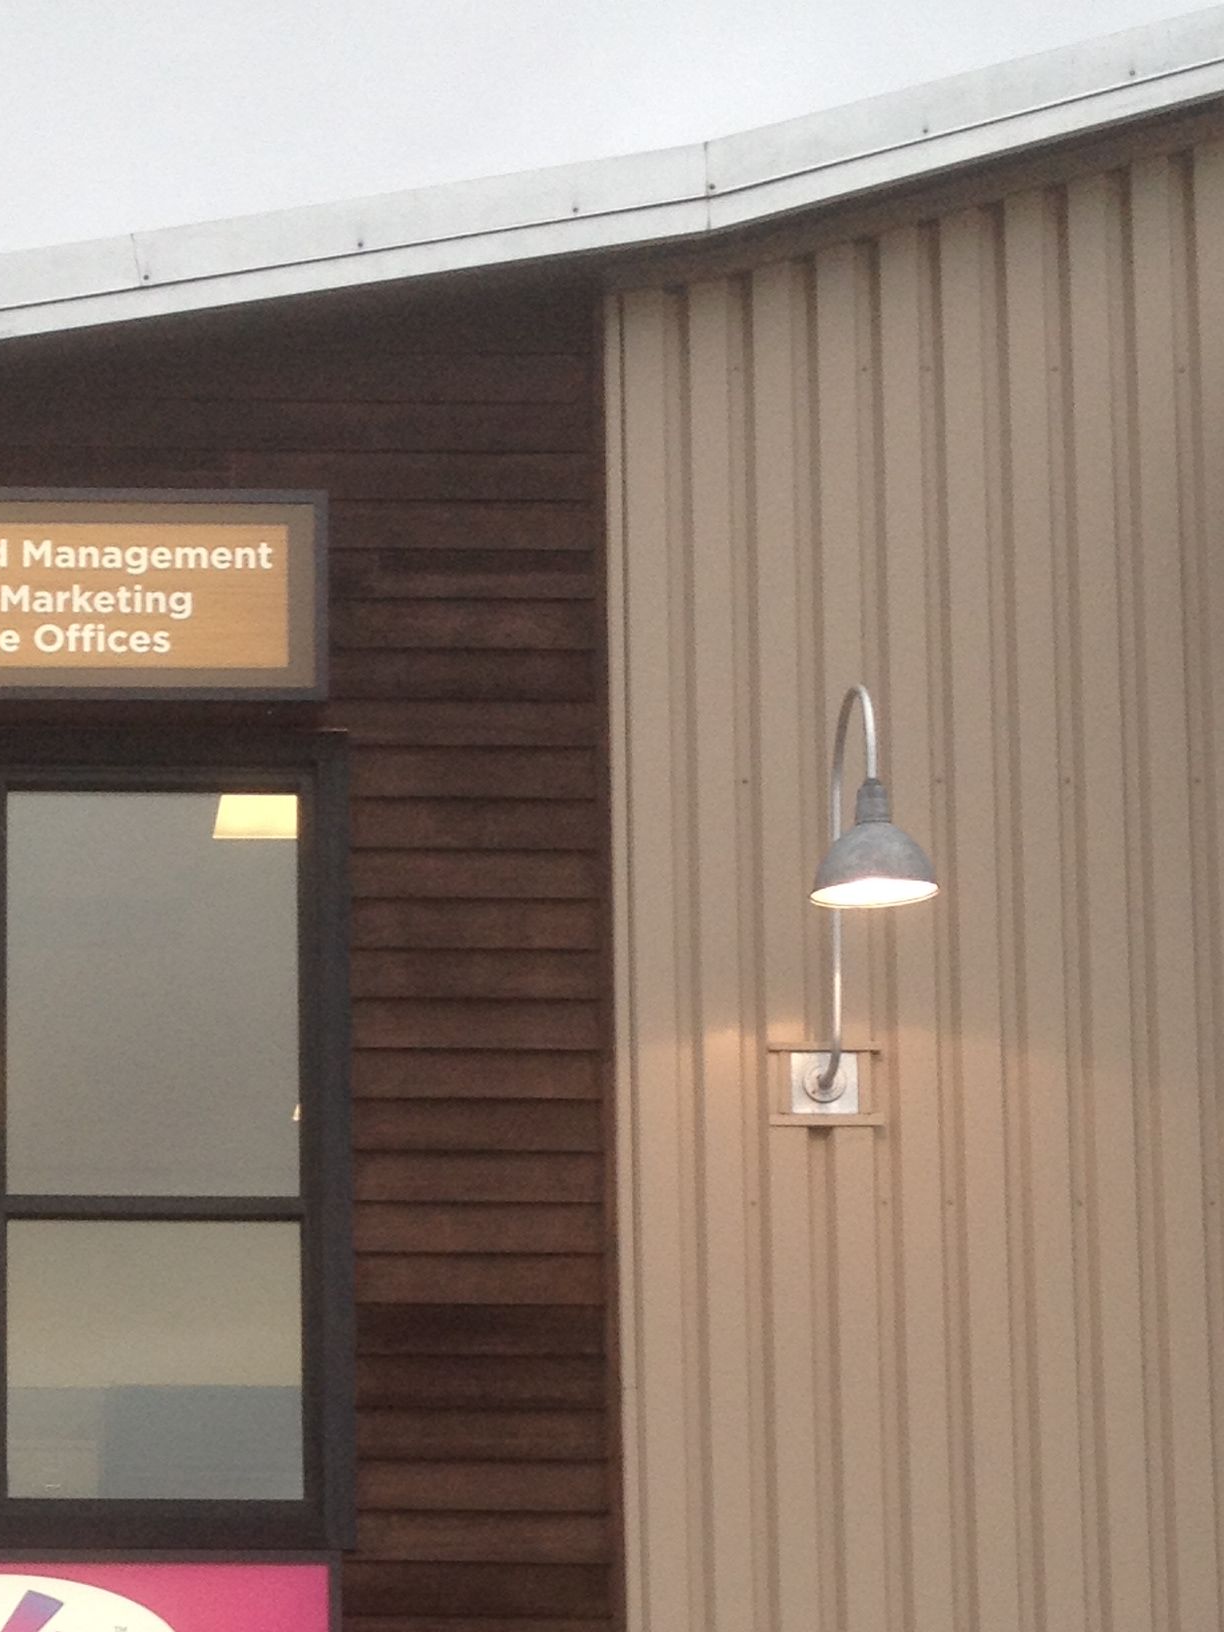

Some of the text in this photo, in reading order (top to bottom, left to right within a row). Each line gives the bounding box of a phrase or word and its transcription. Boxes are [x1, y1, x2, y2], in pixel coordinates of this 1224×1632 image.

[23, 540, 272, 574] Management
[1, 585, 192, 619] Marketing
[34, 623, 171, 653] Offices
